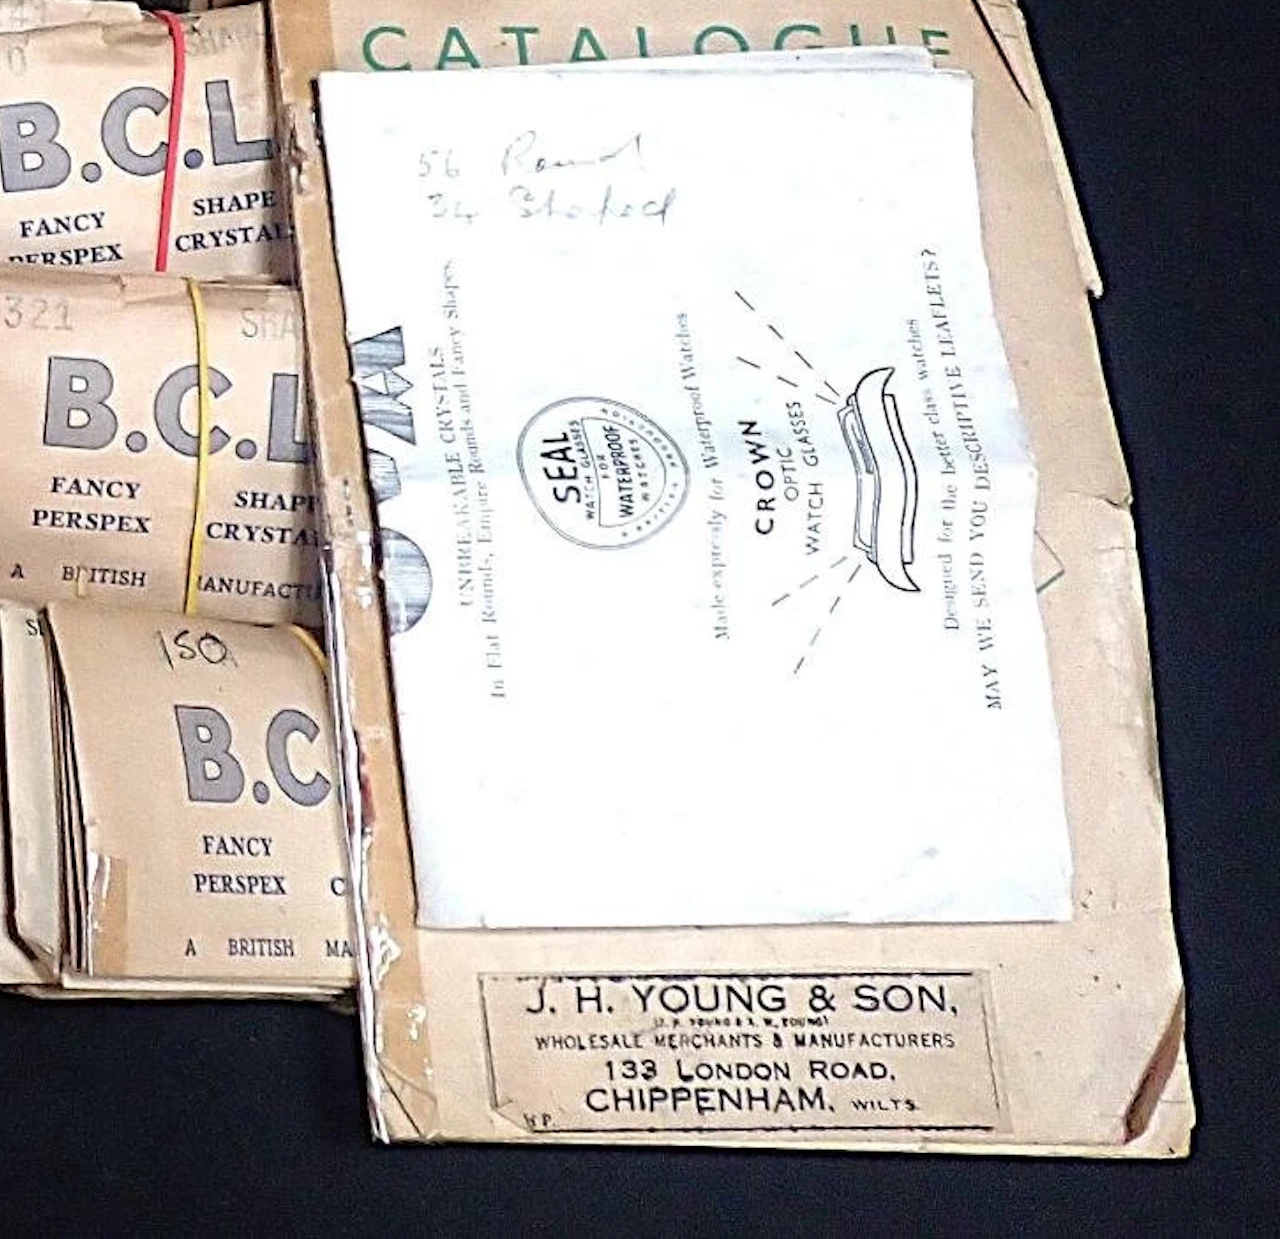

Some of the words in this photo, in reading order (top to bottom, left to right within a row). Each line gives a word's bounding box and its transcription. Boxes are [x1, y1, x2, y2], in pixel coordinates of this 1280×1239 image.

[19, 211, 107, 239] FANCY
[192, 190, 277, 217] SHAPE
[905, 318, 929, 381] watches
[429, 345, 456, 444] CRYSTALS
[568, 419, 590, 469] GLASSES
[683, 384, 720, 469] Waterproof
[785, 400, 820, 467] GLASSES
[944, 363, 992, 490] DESCRIPTIVE
[540, 431, 582, 504] SEAL
[596, 453, 610, 480] FOR
[602, 424, 635, 518] WATERPROOF
[627, 438, 650, 502] WATCHES
[776, 446, 800, 502] OPTIC
[931, 430, 957, 476] better
[50, 475, 141, 501] FANCY
[737, 420, 776, 536] CROWN
[32, 508, 152, 535] PERSPEX
[804, 481, 824, 556] WATCH
[937, 518, 954, 543] for
[969, 499, 989, 542] YOU
[8, 563, 25, 580] A
[969, 551, 988, 609] SEND
[975, 617, 995, 652] WE
[980, 663, 1003, 710] MAY
[202, 834, 274, 858] FANCY
[193, 872, 287, 897] PERSPEX
[184, 938, 196, 957] A
[227, 937, 295, 958] BRITISH
[526, 986, 556, 1014] J.
[577, 986, 613, 1014] H.
[634, 985, 786, 1014] YOUNG
[808, 986, 836, 1013] &
[853, 985, 958, 1017] SON,
[535, 1033, 643, 1050] WHOLESALE
[654, 1032, 763, 1049] MERCHANTS
[794, 1032, 956, 1049] MANUFACTURERS
[605, 1060, 658, 1081] 133
[677, 1061, 792, 1081] LONDON
[585, 1087, 835, 1115] CHIPPENHAM,
